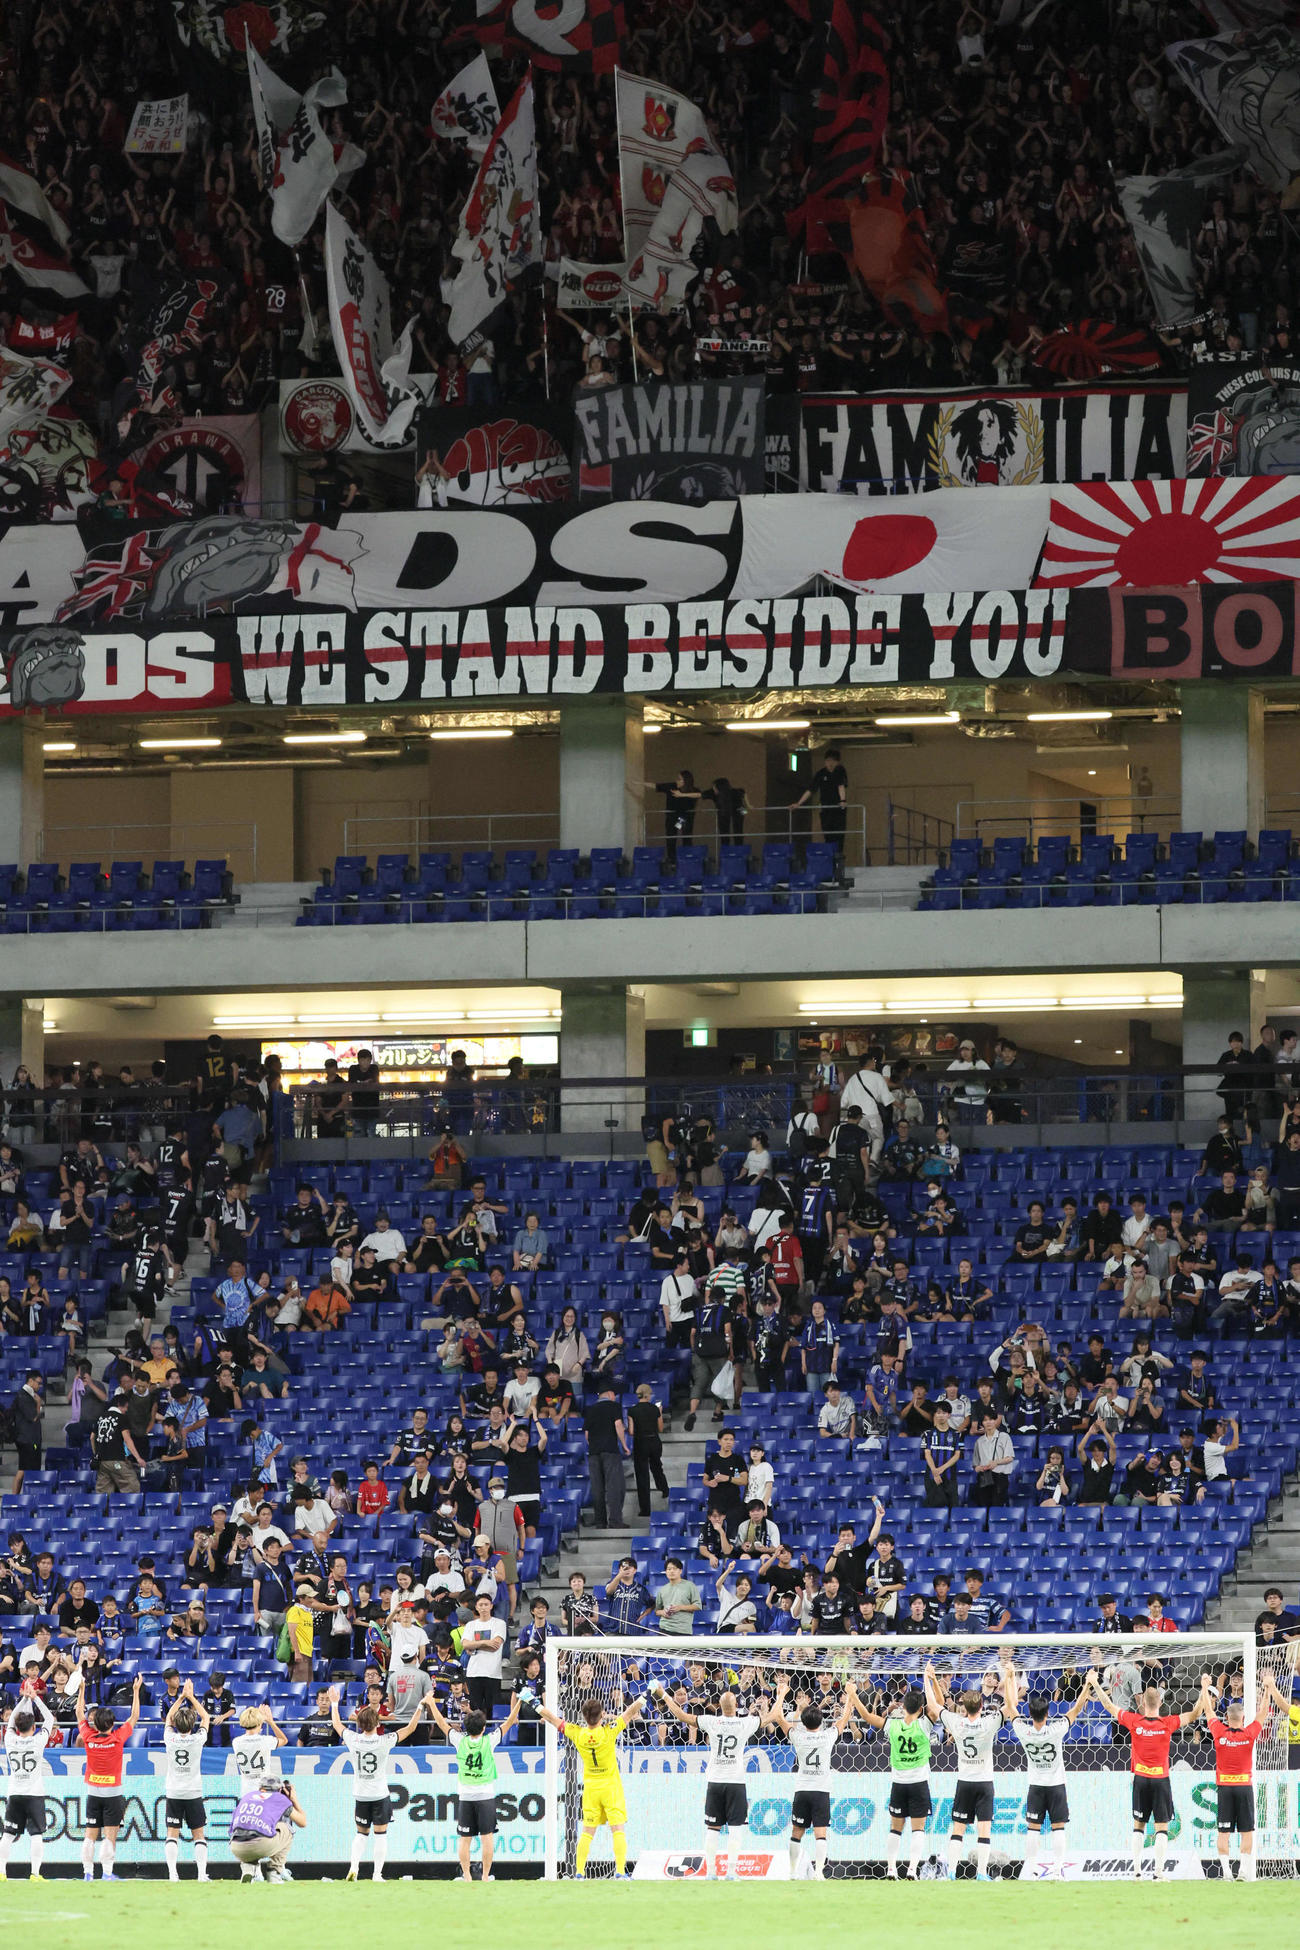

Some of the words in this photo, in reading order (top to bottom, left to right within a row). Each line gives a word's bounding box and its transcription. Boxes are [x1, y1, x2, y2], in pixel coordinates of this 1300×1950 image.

[265, 287, 287, 308] 78
[1215, 375, 1247, 402] THESE
[575, 385, 761, 465] FAMILIA
[159, 432, 231, 456] URAWA
[237, 612, 347, 705] WE
[364, 606, 605, 702] STAND
[623, 595, 902, 692] BESIDE
[922, 588, 1070, 681] YOU
[206, 1056, 226, 1077] 12
[160, 1145, 174, 1163] 12
[169, 1199, 179, 1218] 7
[804, 1195, 815, 1212] 7
[702, 1308, 712, 1325] 7
[716, 1734, 738, 1758] 12
[897, 1735, 918, 1754] 26
[962, 1736, 978, 1758] 5
[1025, 1742, 1057, 1762] 23
[175, 1749, 190, 1766] 8
[236, 1750, 265, 1774] 24
[355, 1750, 378, 1773] 13
[465, 1750, 483, 1771] 44
[805, 1748, 821, 1769] 4
[239, 1802, 263, 1816] 030
[240, 1814, 273, 1835] OFFICIAL
